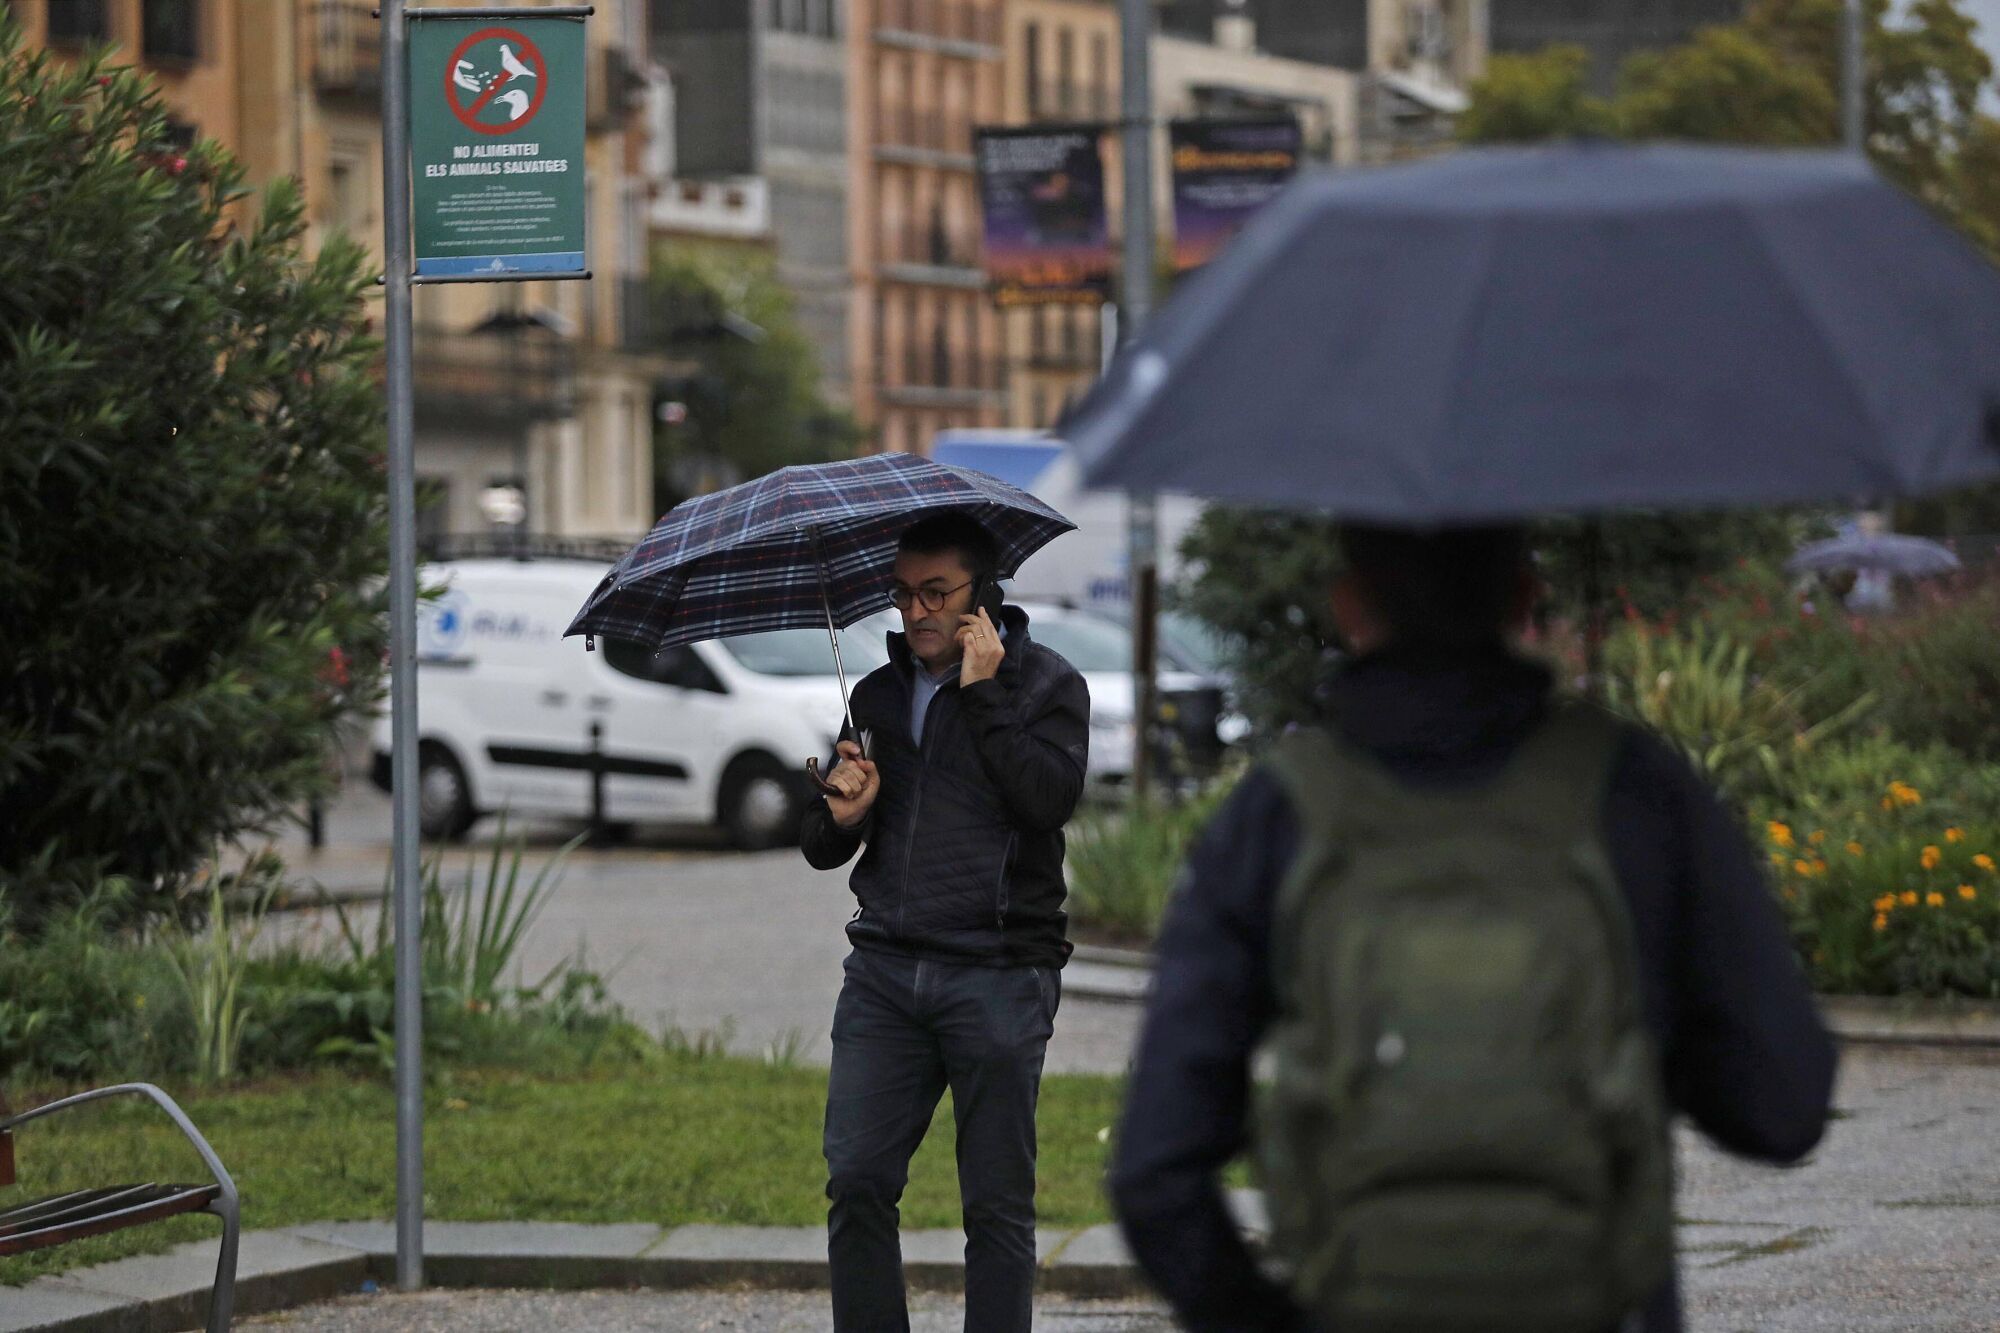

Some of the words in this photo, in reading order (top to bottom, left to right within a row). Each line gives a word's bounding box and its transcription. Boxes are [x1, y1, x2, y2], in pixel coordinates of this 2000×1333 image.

[454, 146, 471, 158] NO
[472, 143, 539, 157] ALIMENTEU
[426, 164, 447, 177] ELS
[449, 162, 501, 176] ANIMALS
[503, 160, 568, 174] SALVATGES
